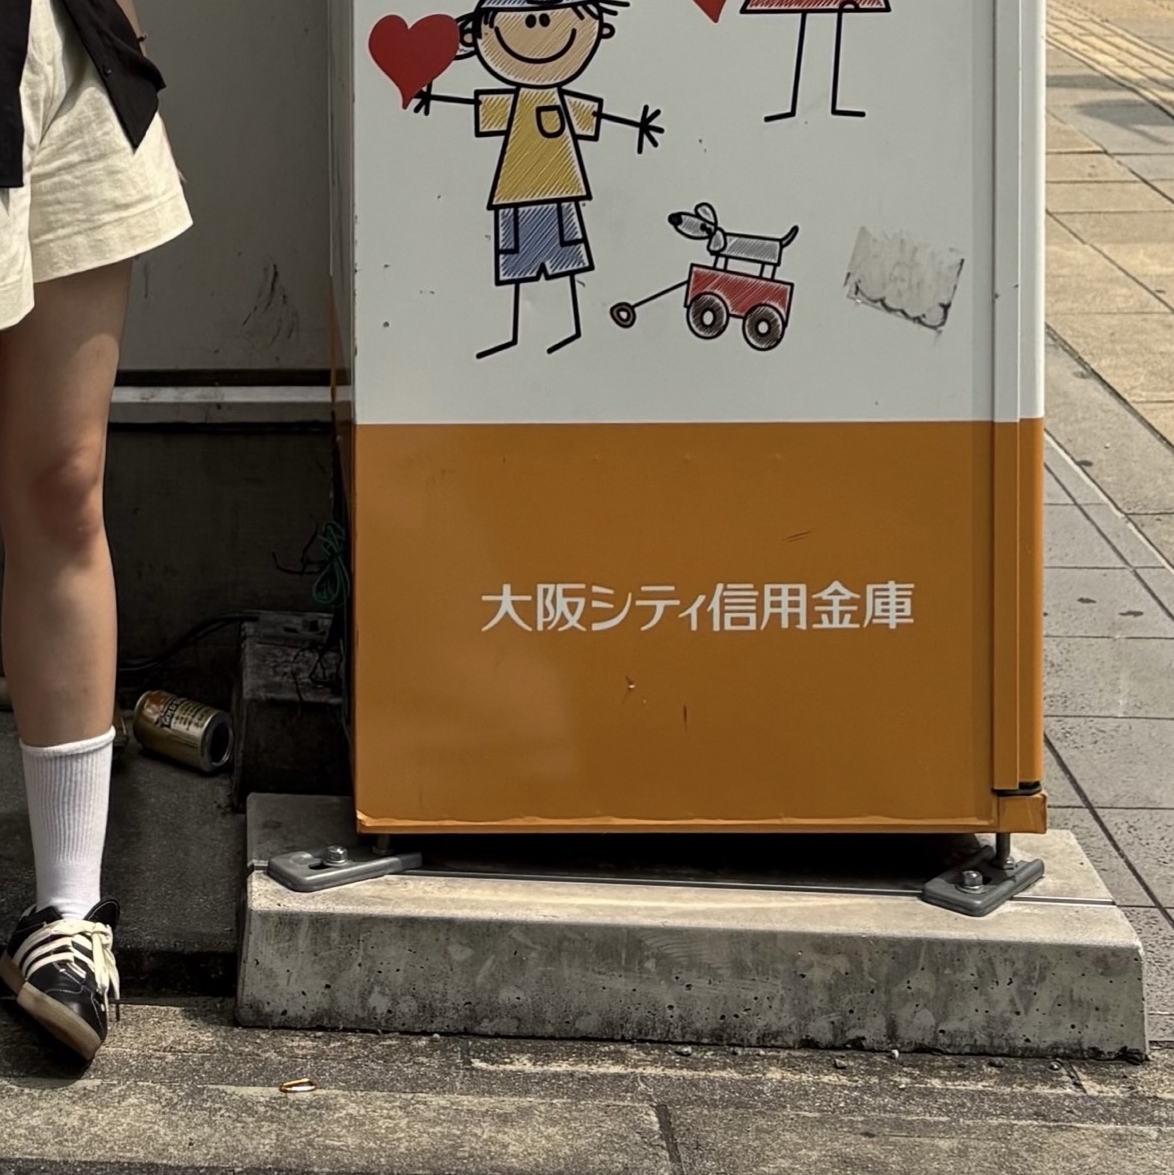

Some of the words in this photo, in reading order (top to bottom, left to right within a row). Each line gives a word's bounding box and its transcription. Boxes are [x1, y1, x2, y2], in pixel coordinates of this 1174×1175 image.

[481, 580, 914, 632] 大阪シティ信用金庫
